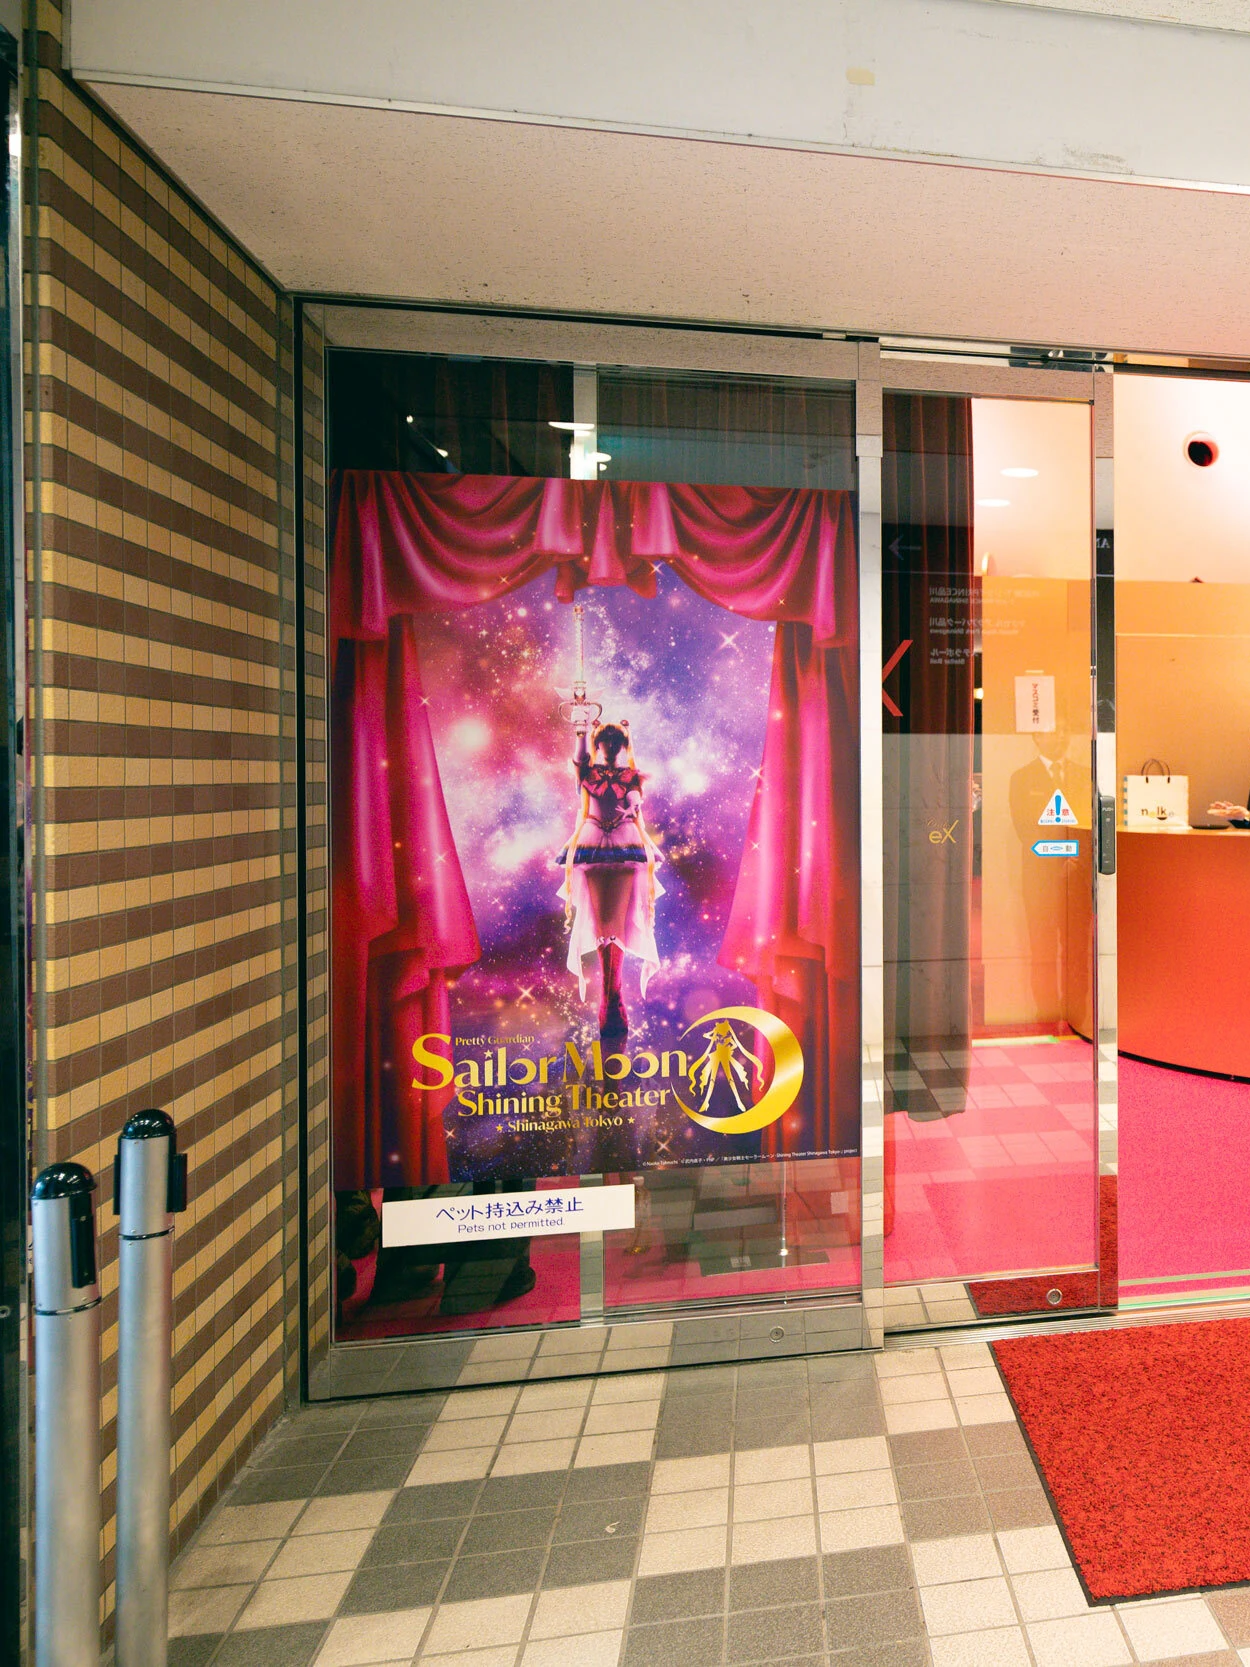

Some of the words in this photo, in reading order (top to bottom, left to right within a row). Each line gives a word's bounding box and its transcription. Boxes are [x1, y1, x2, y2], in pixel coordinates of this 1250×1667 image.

[929, 819, 959, 844] eX
[455, 1036, 485, 1046] Pretty
[488, 1034, 535, 1044] Guardian
[411, 1033, 557, 1090] Sailor
[563, 1040, 687, 1082] Moon
[458, 1090, 562, 1118] Shining
[565, 1083, 671, 1111] Theater
[507, 1119, 580, 1133] Shinagawa
[585, 1115, 623, 1129] Tokyo
[436, 1197, 584, 1220] ペット持込み禁止
[458, 1224, 485, 1233] Pets
[488, 1222, 506, 1231] not
